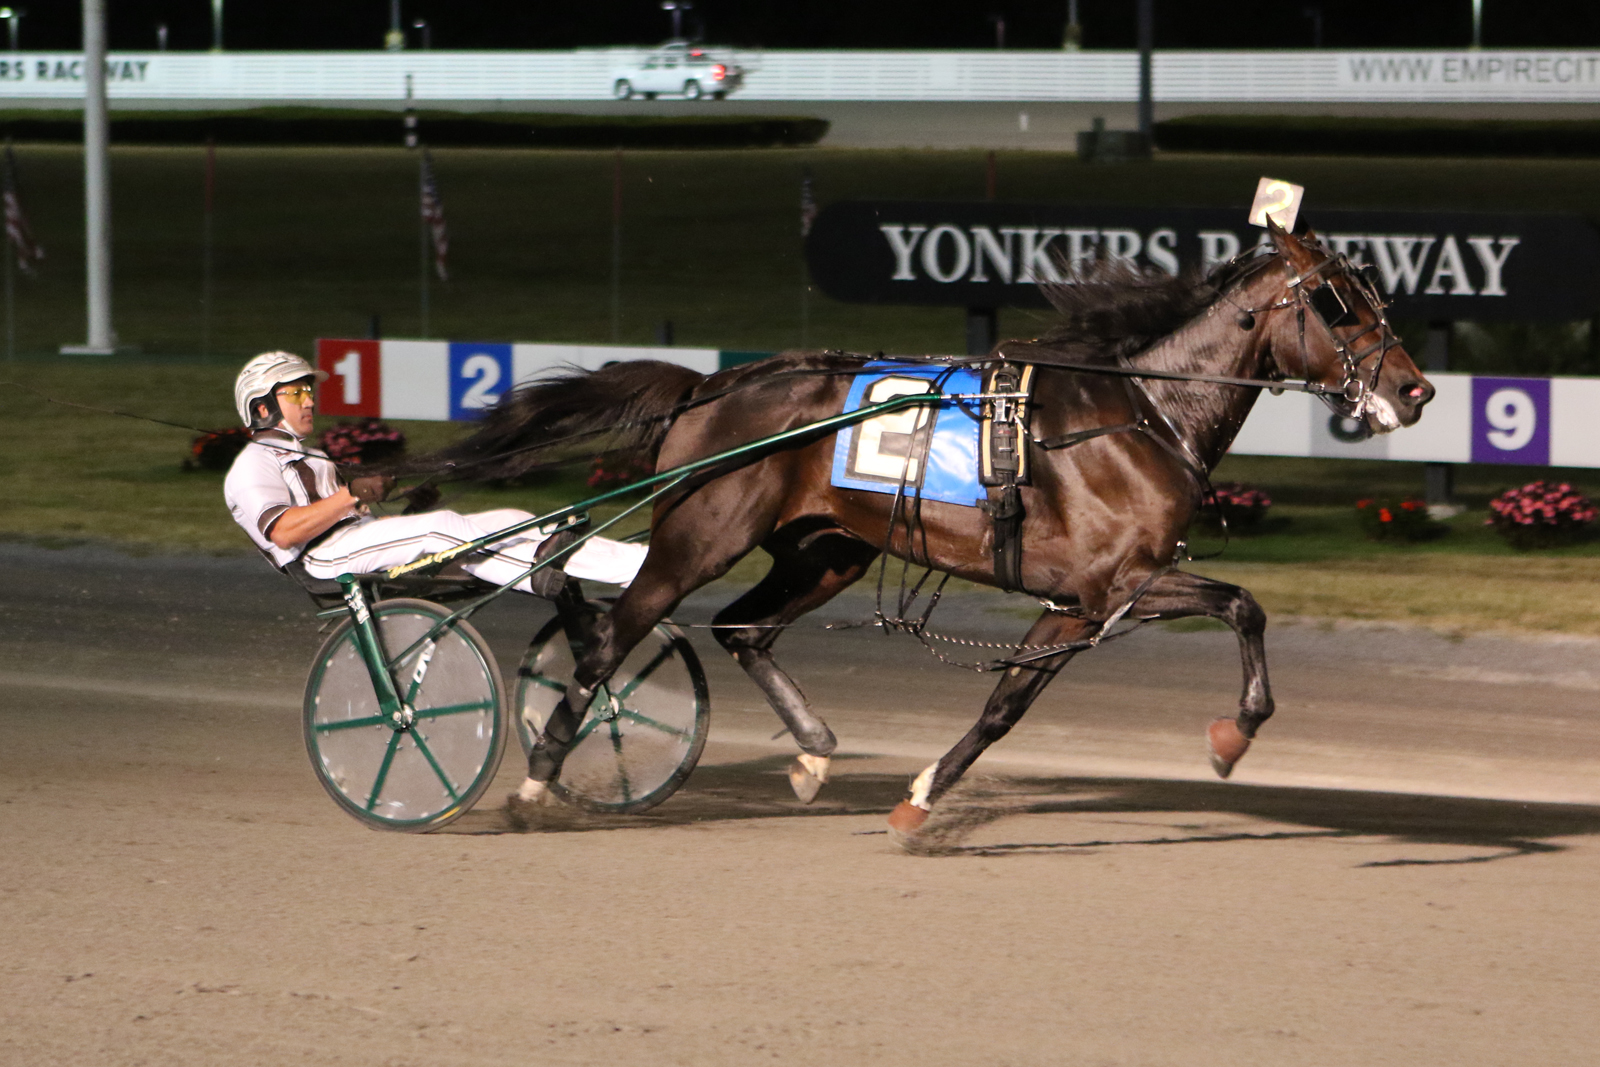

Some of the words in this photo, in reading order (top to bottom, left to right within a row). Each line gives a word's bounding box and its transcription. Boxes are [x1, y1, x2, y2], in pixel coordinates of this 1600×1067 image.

[37, 60, 149, 82] RACWAY
[1256, 180, 1294, 228] 2
[879, 224, 1180, 285] YONKERS
[1197, 229, 1521, 297] REWAY
[333, 350, 362, 405] 1
[461, 354, 501, 409] 2
[852, 375, 934, 484] 2
[1485, 387, 1537, 451] 9
